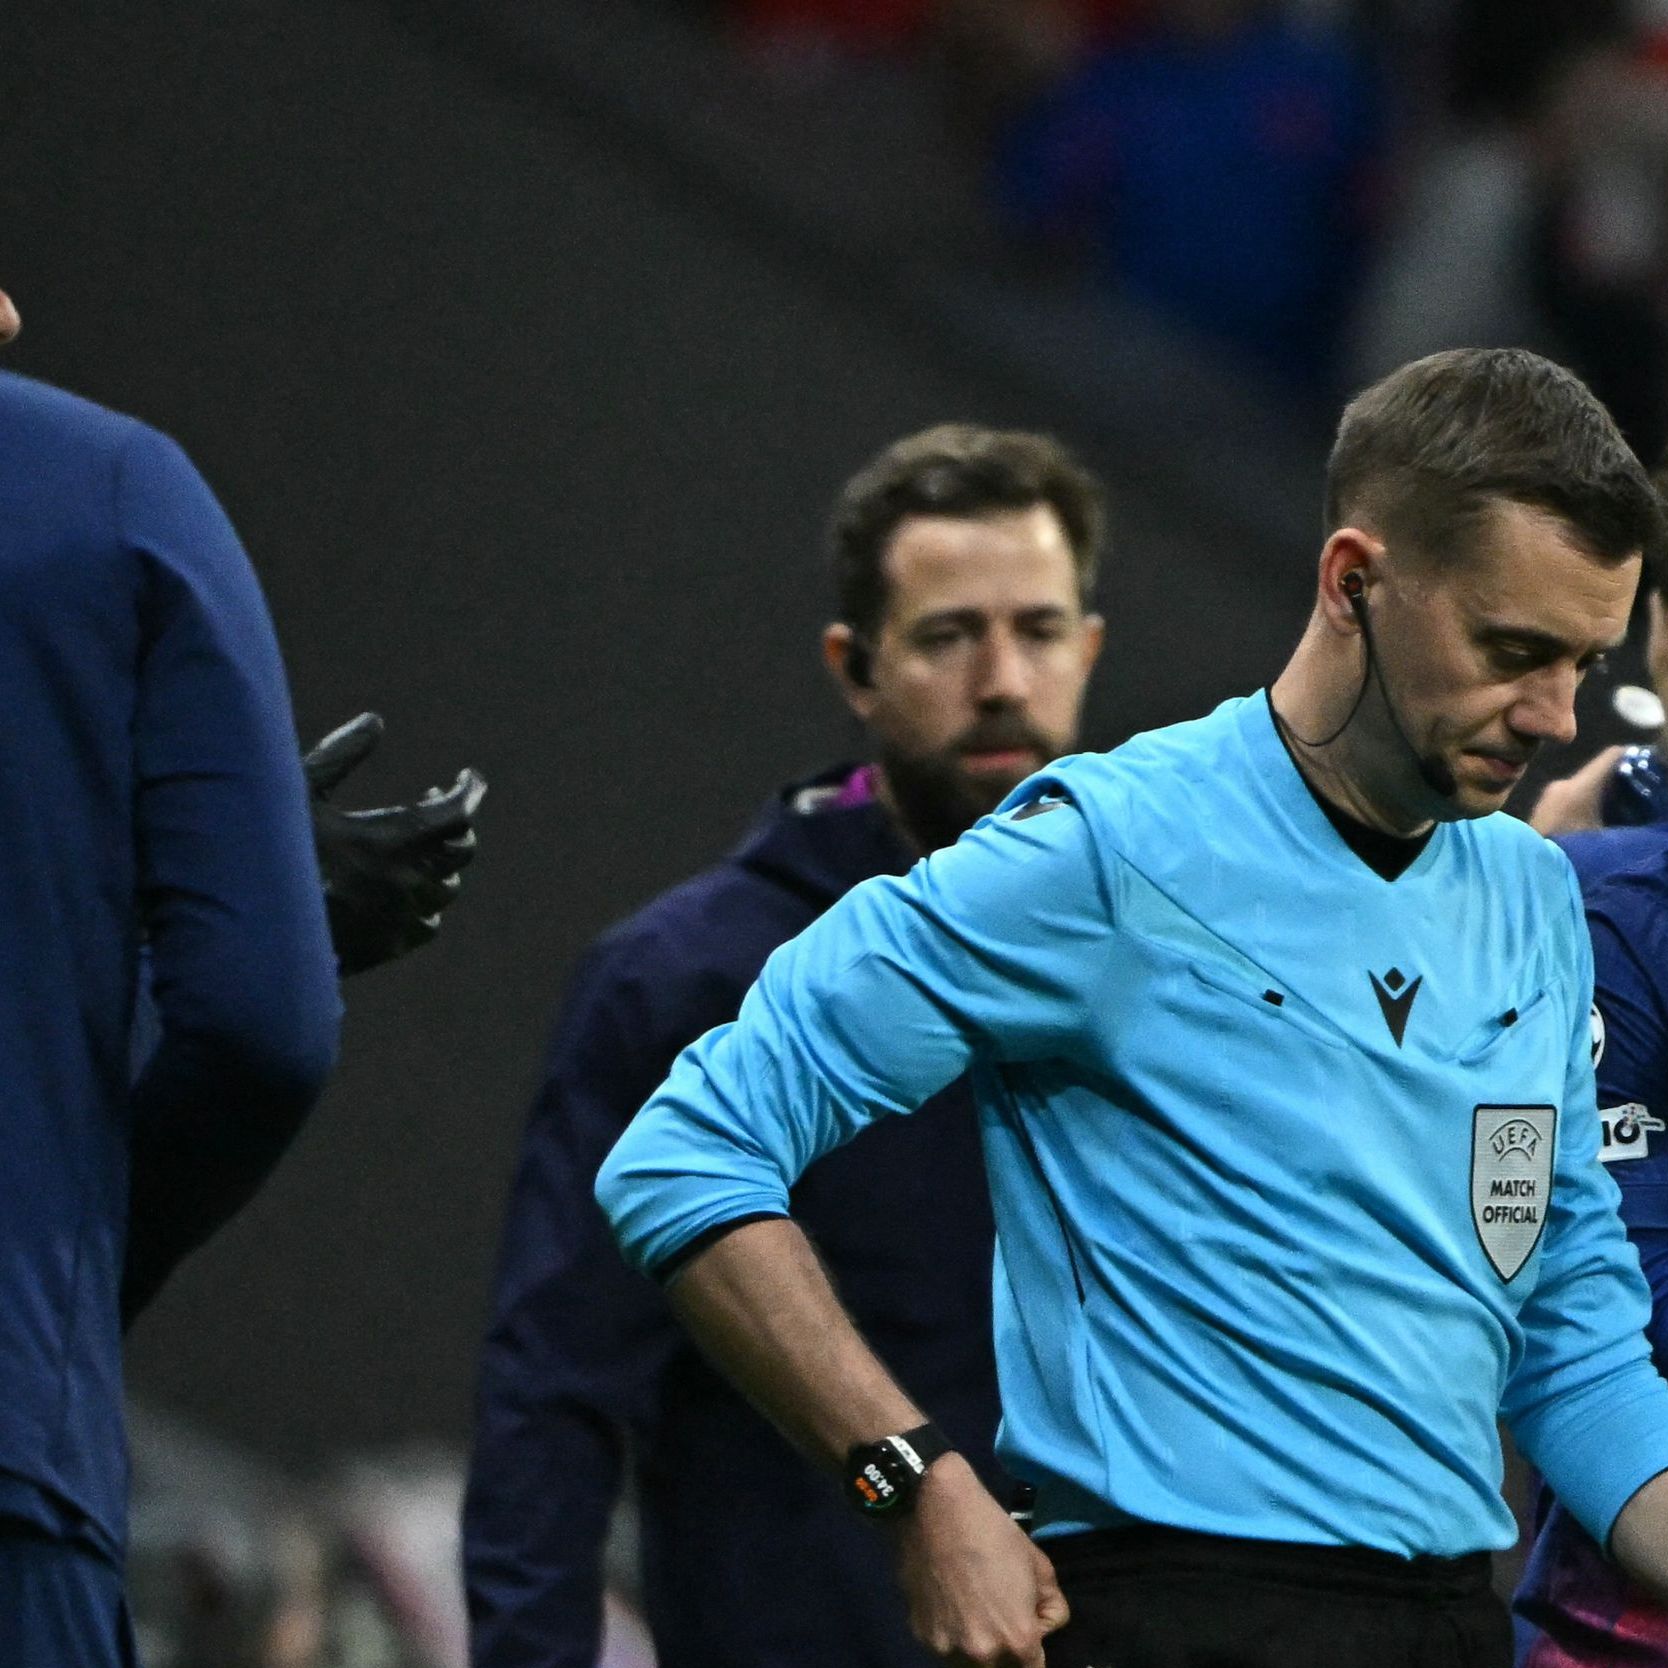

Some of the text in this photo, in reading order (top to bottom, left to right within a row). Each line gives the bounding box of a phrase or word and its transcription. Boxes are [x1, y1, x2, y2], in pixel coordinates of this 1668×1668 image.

[1492, 1126, 1537, 1157] UEFA
[1489, 1180, 1536, 1197] MATCH
[1482, 1205, 1538, 1224] OFFICIAL
